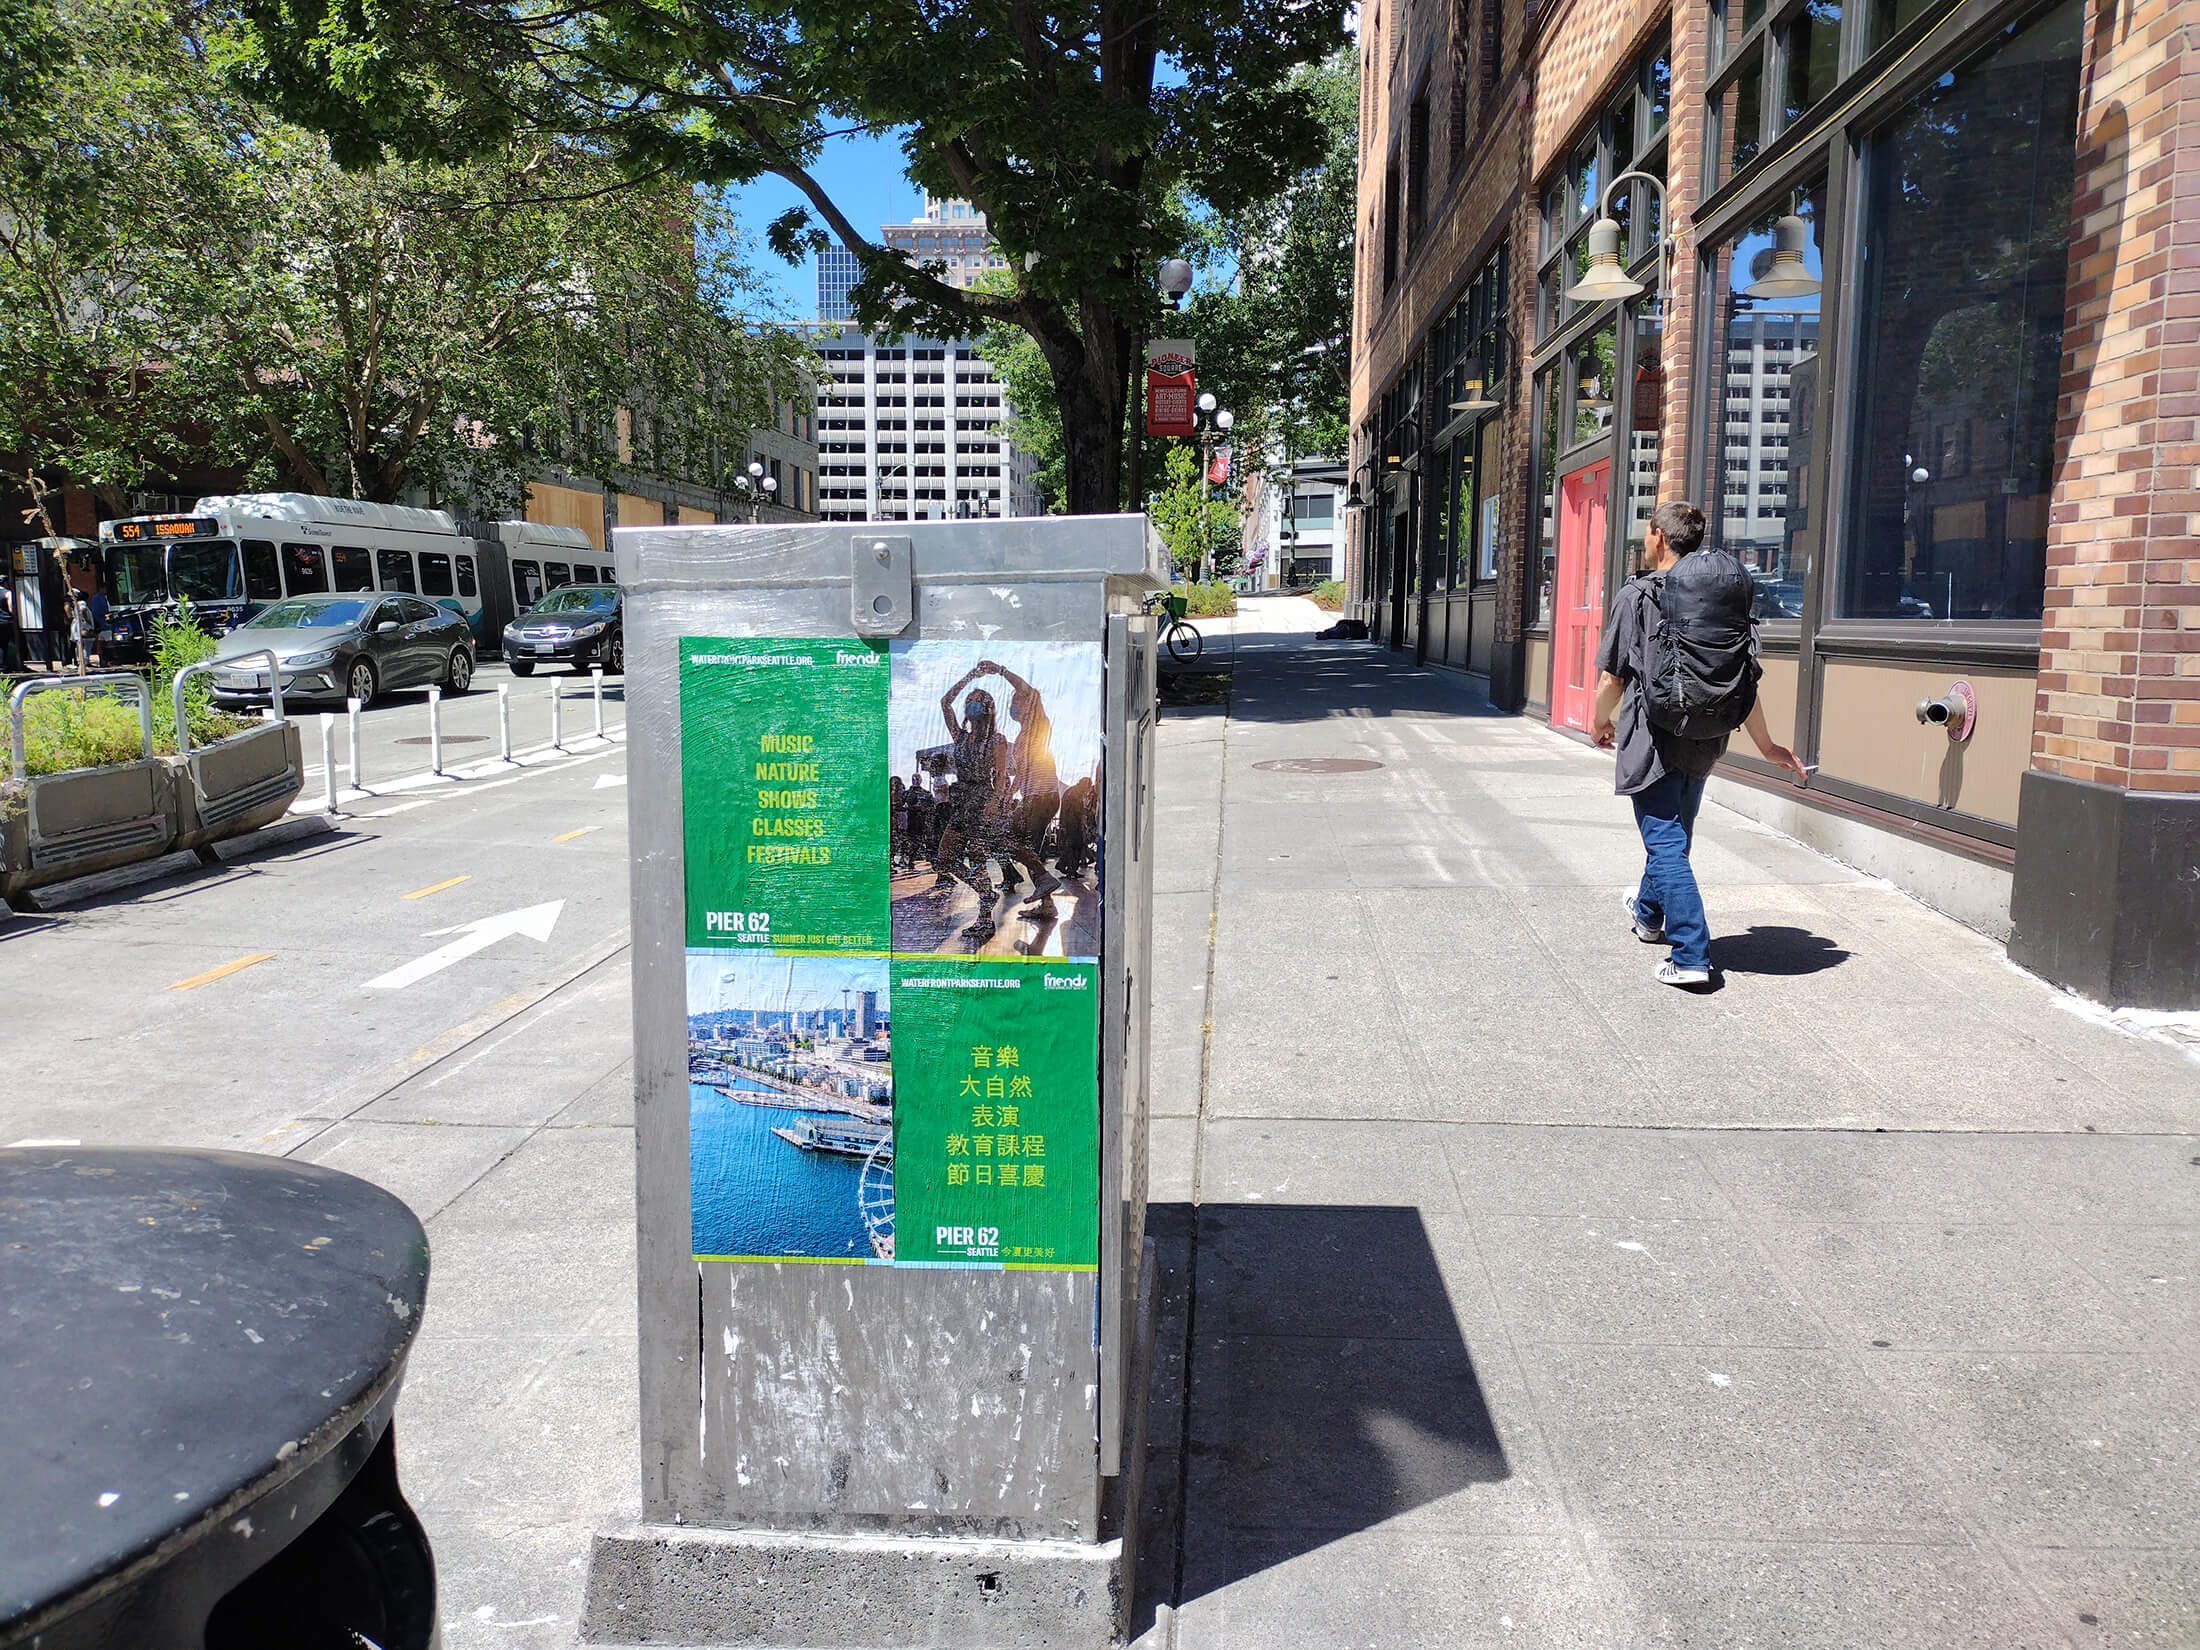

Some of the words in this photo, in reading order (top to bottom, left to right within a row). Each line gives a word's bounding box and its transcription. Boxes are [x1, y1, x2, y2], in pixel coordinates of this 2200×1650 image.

[1151, 352, 1192, 367] PIONEER
[1159, 364, 1182, 372] SQUARE
[122, 525, 140, 538] 554
[155, 522, 195, 536] ISSAQUAH
[690, 654, 812, 666] WATERFRONTPARKSEATTLE.ORG
[836, 650, 880, 665] friends
[760, 734, 814, 753] MUSIC
[756, 762, 819, 781] NATURE
[758, 790, 817, 809] SHOWS
[752, 818, 824, 837] CLASSES
[747, 845, 832, 864] FESTIVALS
[706, 911, 744, 931] PIER
[748, 912, 769, 932] 62
[737, 933, 769, 943] SEATTLE
[772, 934, 805, 944] SUMMER
[807, 935, 825, 944] JUST
[826, 935, 842, 945] GOT
[901, 978, 1020, 989] WATERFRONTPARKSEATTLE.ORG
[1043, 973, 1087, 987] friends
[971, 1045, 1019, 1069] 音樂
[959, 1074, 1032, 1098] 大自然
[971, 1104, 1020, 1127] 表演
[945, 1132, 1046, 1158] 教育課程
[947, 1162, 1045, 1187] 節日喜慶
[936, 1226, 974, 1245] PIER
[977, 1227, 998, 1246] 62
[966, 1247, 998, 1257] SEATTLE
[1001, 1246, 1055, 1258] 今夏更美好
